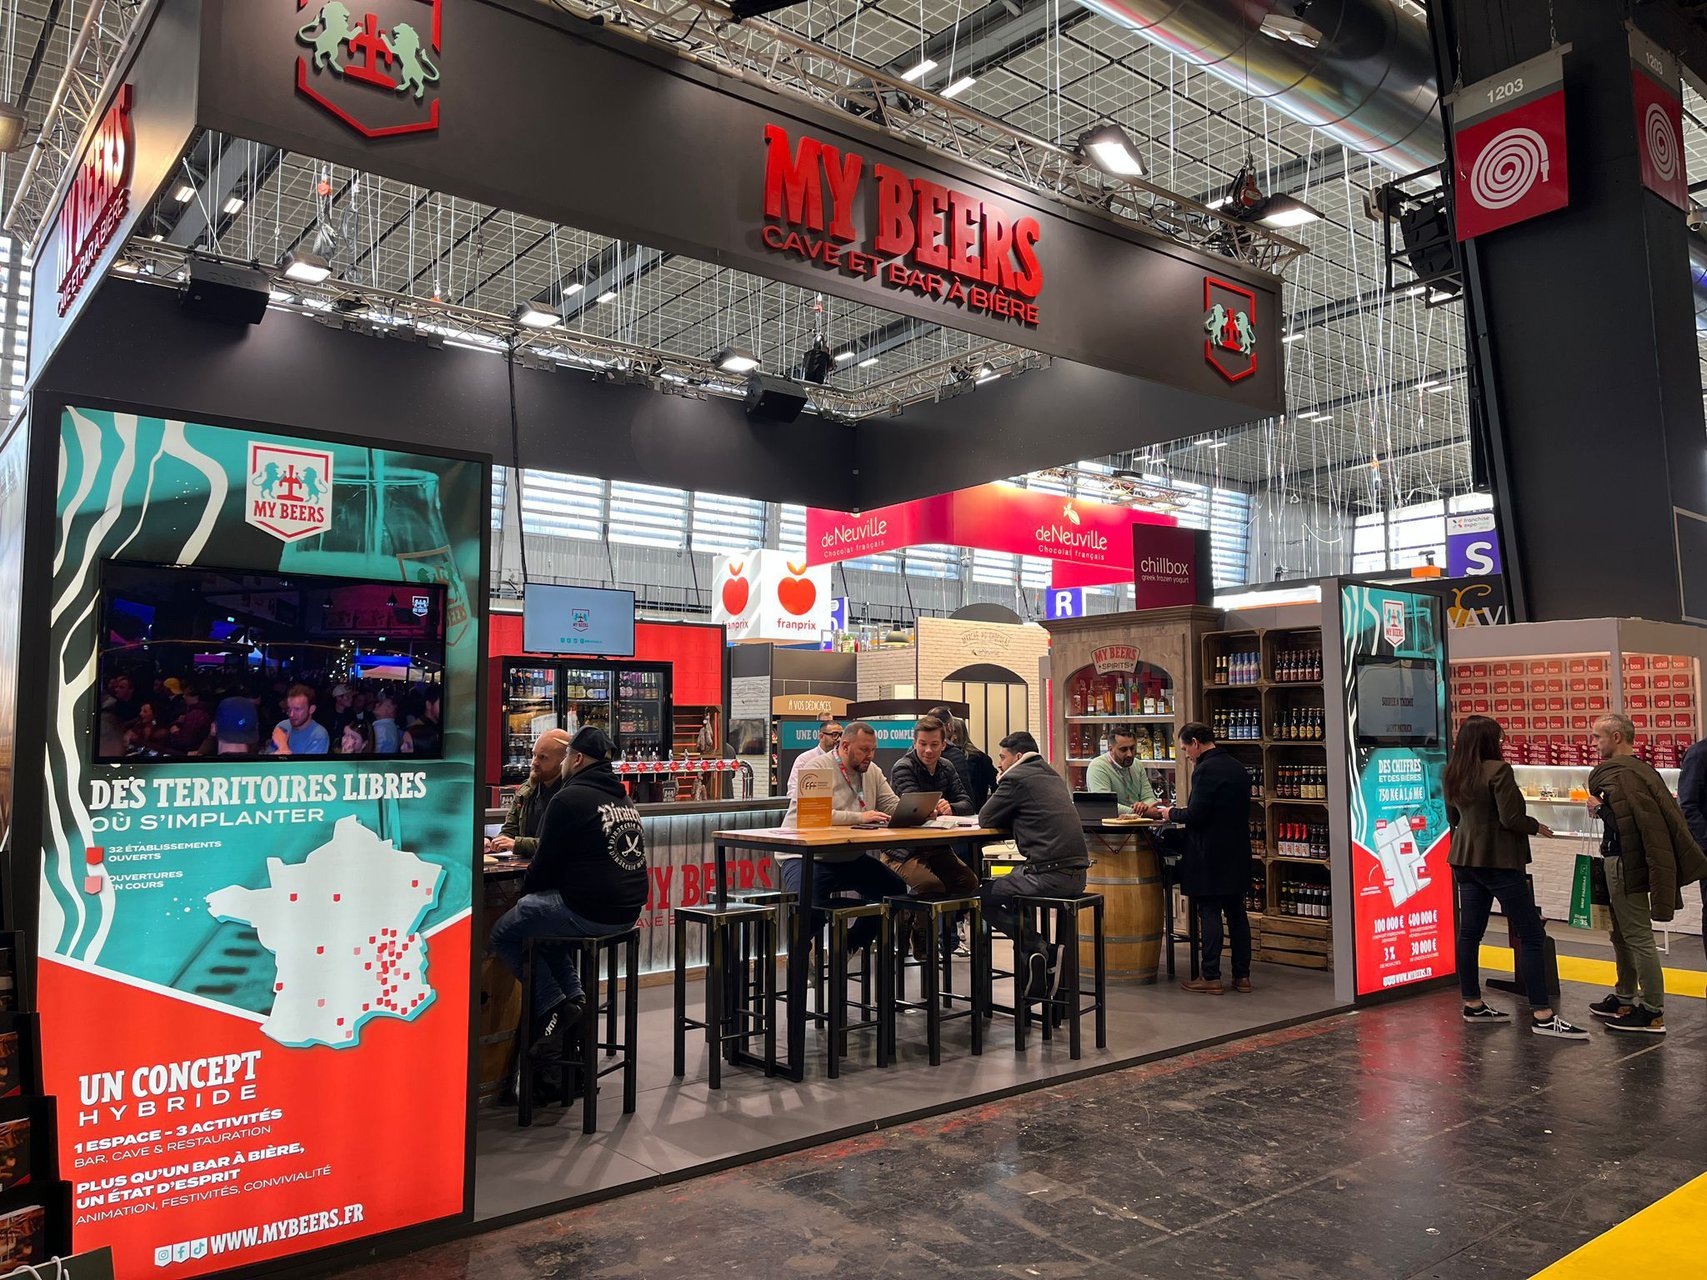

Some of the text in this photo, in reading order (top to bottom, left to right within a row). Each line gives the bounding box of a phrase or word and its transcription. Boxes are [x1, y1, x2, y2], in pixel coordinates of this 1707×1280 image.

[1646, 52, 1664, 75] 1203
[1488, 78, 1524, 104] 1203
[764, 123, 1043, 298] MY BEERS
[762, 225, 1040, 325] CAVE ET BAR À BIÈRE
[254, 500, 324, 524] MY BEERS
[821, 516, 887, 548] deNeuville
[1036, 524, 1108, 550] deNeuville
[824, 540, 884, 558] Chocolat français
[1038, 544, 1104, 560] Chocolat français
[1466, 542, 1494, 576] S
[1140, 557, 1189, 576] chillbox
[1056, 591, 1072, 616] R
[777, 618, 816, 631] franprix
[1094, 646, 1137, 664] MY BEERS
[1102, 662, 1130, 670] SPIRITS
[796, 730, 811, 740] UNE
[1378, 758, 1422, 773] DES CHIFFRES
[90, 772, 427, 810] DES TERRITOIRES LIBRES
[90, 808, 324, 832] OÙ S'IMPLANTER
[108, 853, 162, 862] OUVERTS
[126, 840, 222, 854] ÉTABLISSEMENTS
[126, 881, 164, 890] COURS
[636, 916, 662, 928] AVE
[1384, 948, 1389, 961] 3
[78, 1050, 262, 1106] UN CONCEPT
[79, 1084, 257, 1126] HYBRIDE
[74, 1142, 84, 1154] 1
[86, 1130, 162, 1152] ESPACE
[176, 1126, 188, 1136] 3
[190, 1108, 282, 1134] ACTIVITÉS
[74, 1125, 271, 1168] BAR, CAVE & RESTAURATION
[76, 1142, 304, 1194] PLUS QU'UN BAR À BIÈRE,
[76, 1168, 240, 1210] UN ÉTAT D'ESPRIT
[76, 1164, 332, 1226] ANIMATION, FESTIVITÉS, CONVIVIALITÉ
[210, 1203, 364, 1255] WWW.MYBEERS.FR
